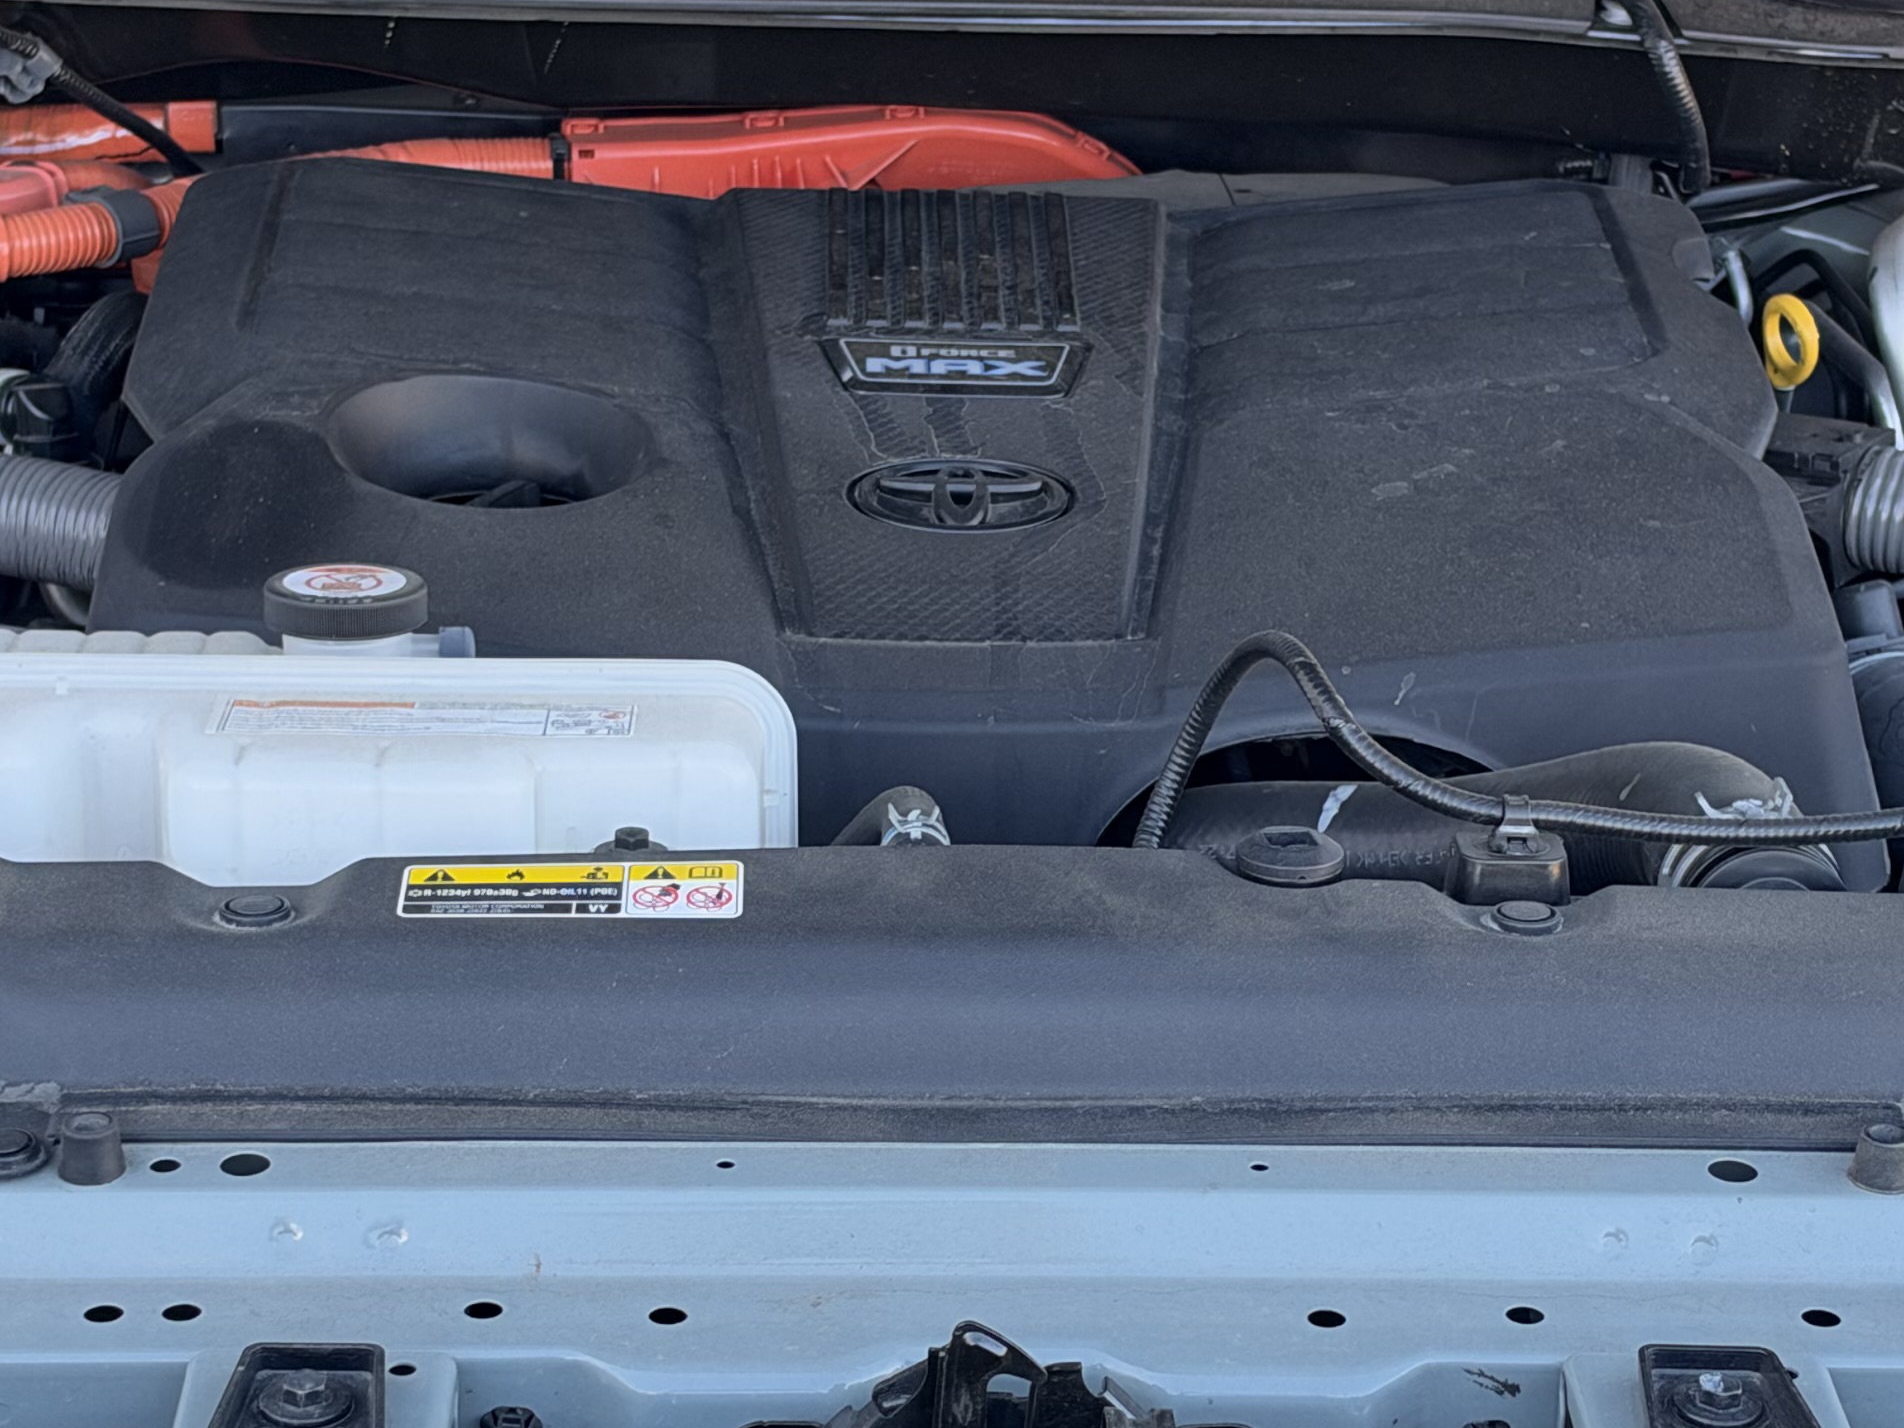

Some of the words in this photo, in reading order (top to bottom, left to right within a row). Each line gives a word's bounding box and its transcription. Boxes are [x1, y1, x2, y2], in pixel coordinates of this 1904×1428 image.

[864, 356, 1048, 376] MAX
[423, 888, 472, 897] R-1234yf
[588, 904, 609, 913] VY
